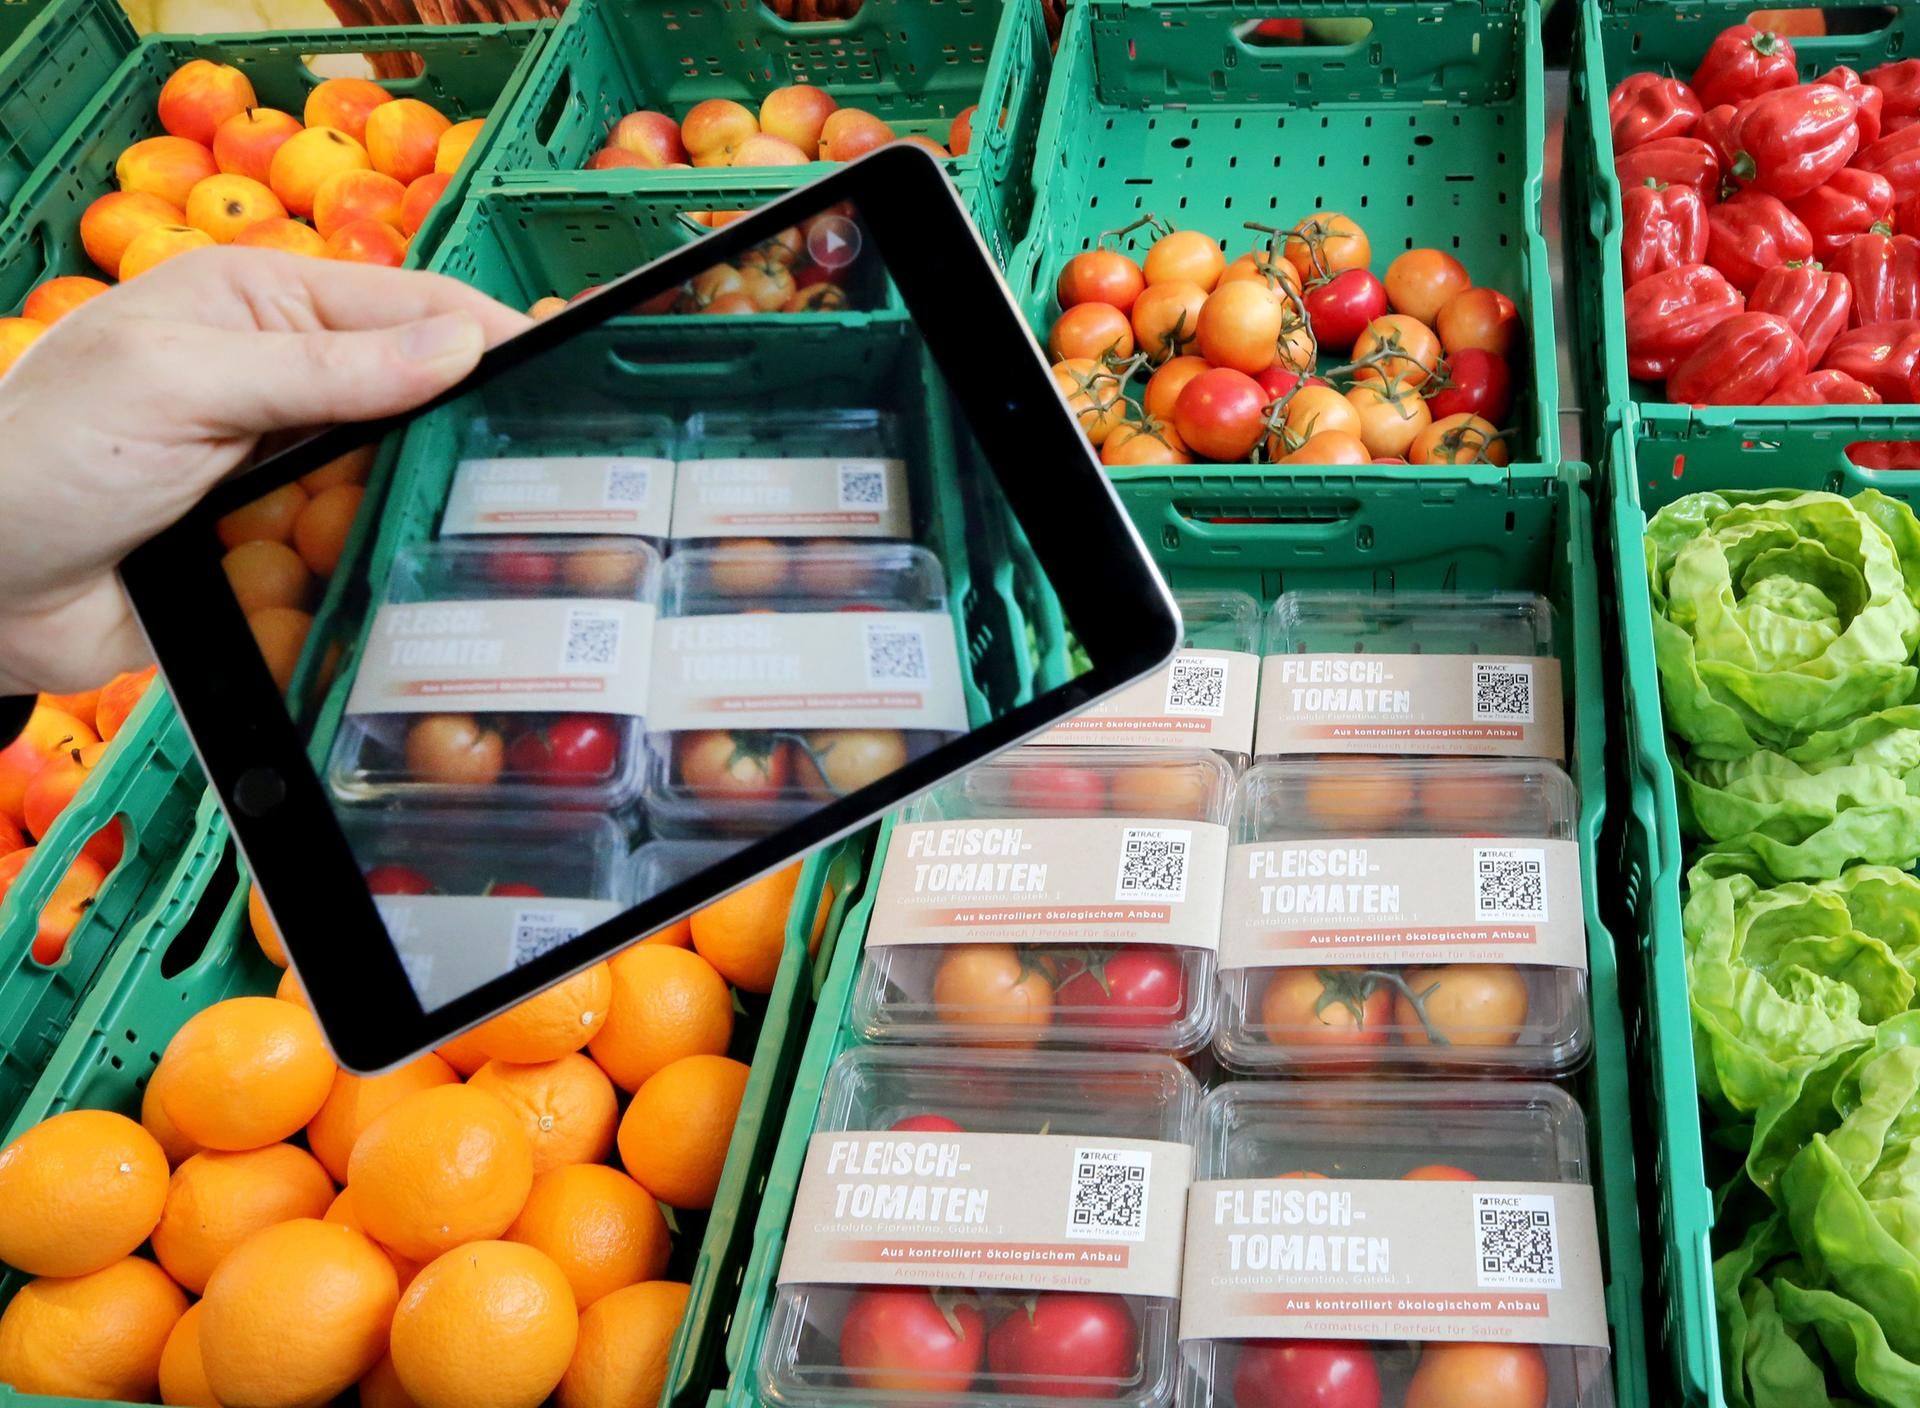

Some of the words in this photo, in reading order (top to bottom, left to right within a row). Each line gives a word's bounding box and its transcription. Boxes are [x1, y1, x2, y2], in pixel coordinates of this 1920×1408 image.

[1282, 660, 1394, 684] FLEISCH-
[1291, 688, 1411, 713] TOMATEN
[1055, 720, 1104, 729] ontrolliert
[1106, 720, 1172, 730] ökologischem
[1175, 721, 1206, 730] Anbau
[1333, 728, 1351, 736] Aus
[1354, 728, 1411, 736] kontrolliert
[1414, 728, 1483, 737] ökologischem
[1486, 728, 1518, 737] Anbau
[907, 828, 1032, 858] FLEISCH-
[1249, 848, 1380, 879] FLEISCH-
[914, 863, 1048, 893] TOMATEN
[1260, 884, 1400, 914] TOMATEN
[954, 912, 975, 921] Aus
[978, 911, 1042, 920] kontrolliert
[1046, 909, 1125, 920] ökologischem
[1127, 909, 1165, 919] Anbau
[1310, 934, 1331, 944] Aus
[1335, 933, 1401, 943] kontrolliert
[1406, 931, 1488, 942] ökologischem
[1492, 930, 1530, 940] Anbau
[827, 1141, 971, 1177] FLEISCH-
[834, 1183, 990, 1224] TOMATEN
[1215, 1190, 1366, 1226] FLEISCH-
[880, 1247, 904, 1257] Aus
[908, 1247, 982, 1259] kontrolliert
[987, 1249, 1075, 1261] ökologischem
[1080, 1251, 1121, 1262] Anbau
[1228, 1234, 1390, 1273] TOMATEN
[895, 1268, 966, 1280] Aromatisch
[978, 1270, 1024, 1282] Perfekt
[1030, 1271, 1047, 1282] für
[1052, 1273, 1092, 1286] Salate
[1286, 1299, 1311, 1310] Aus
[1315, 1299, 1393, 1310] kontrolliert
[1397, 1300, 1492, 1312] ökologischem
[1497, 1300, 1540, 1311] Anbau
[1304, 1319, 1380, 1333] Aromatisch
[1393, 1323, 1441, 1334] Perfekt
[1447, 1323, 1465, 1335] für
[1472, 1325, 1513, 1337] Salate
